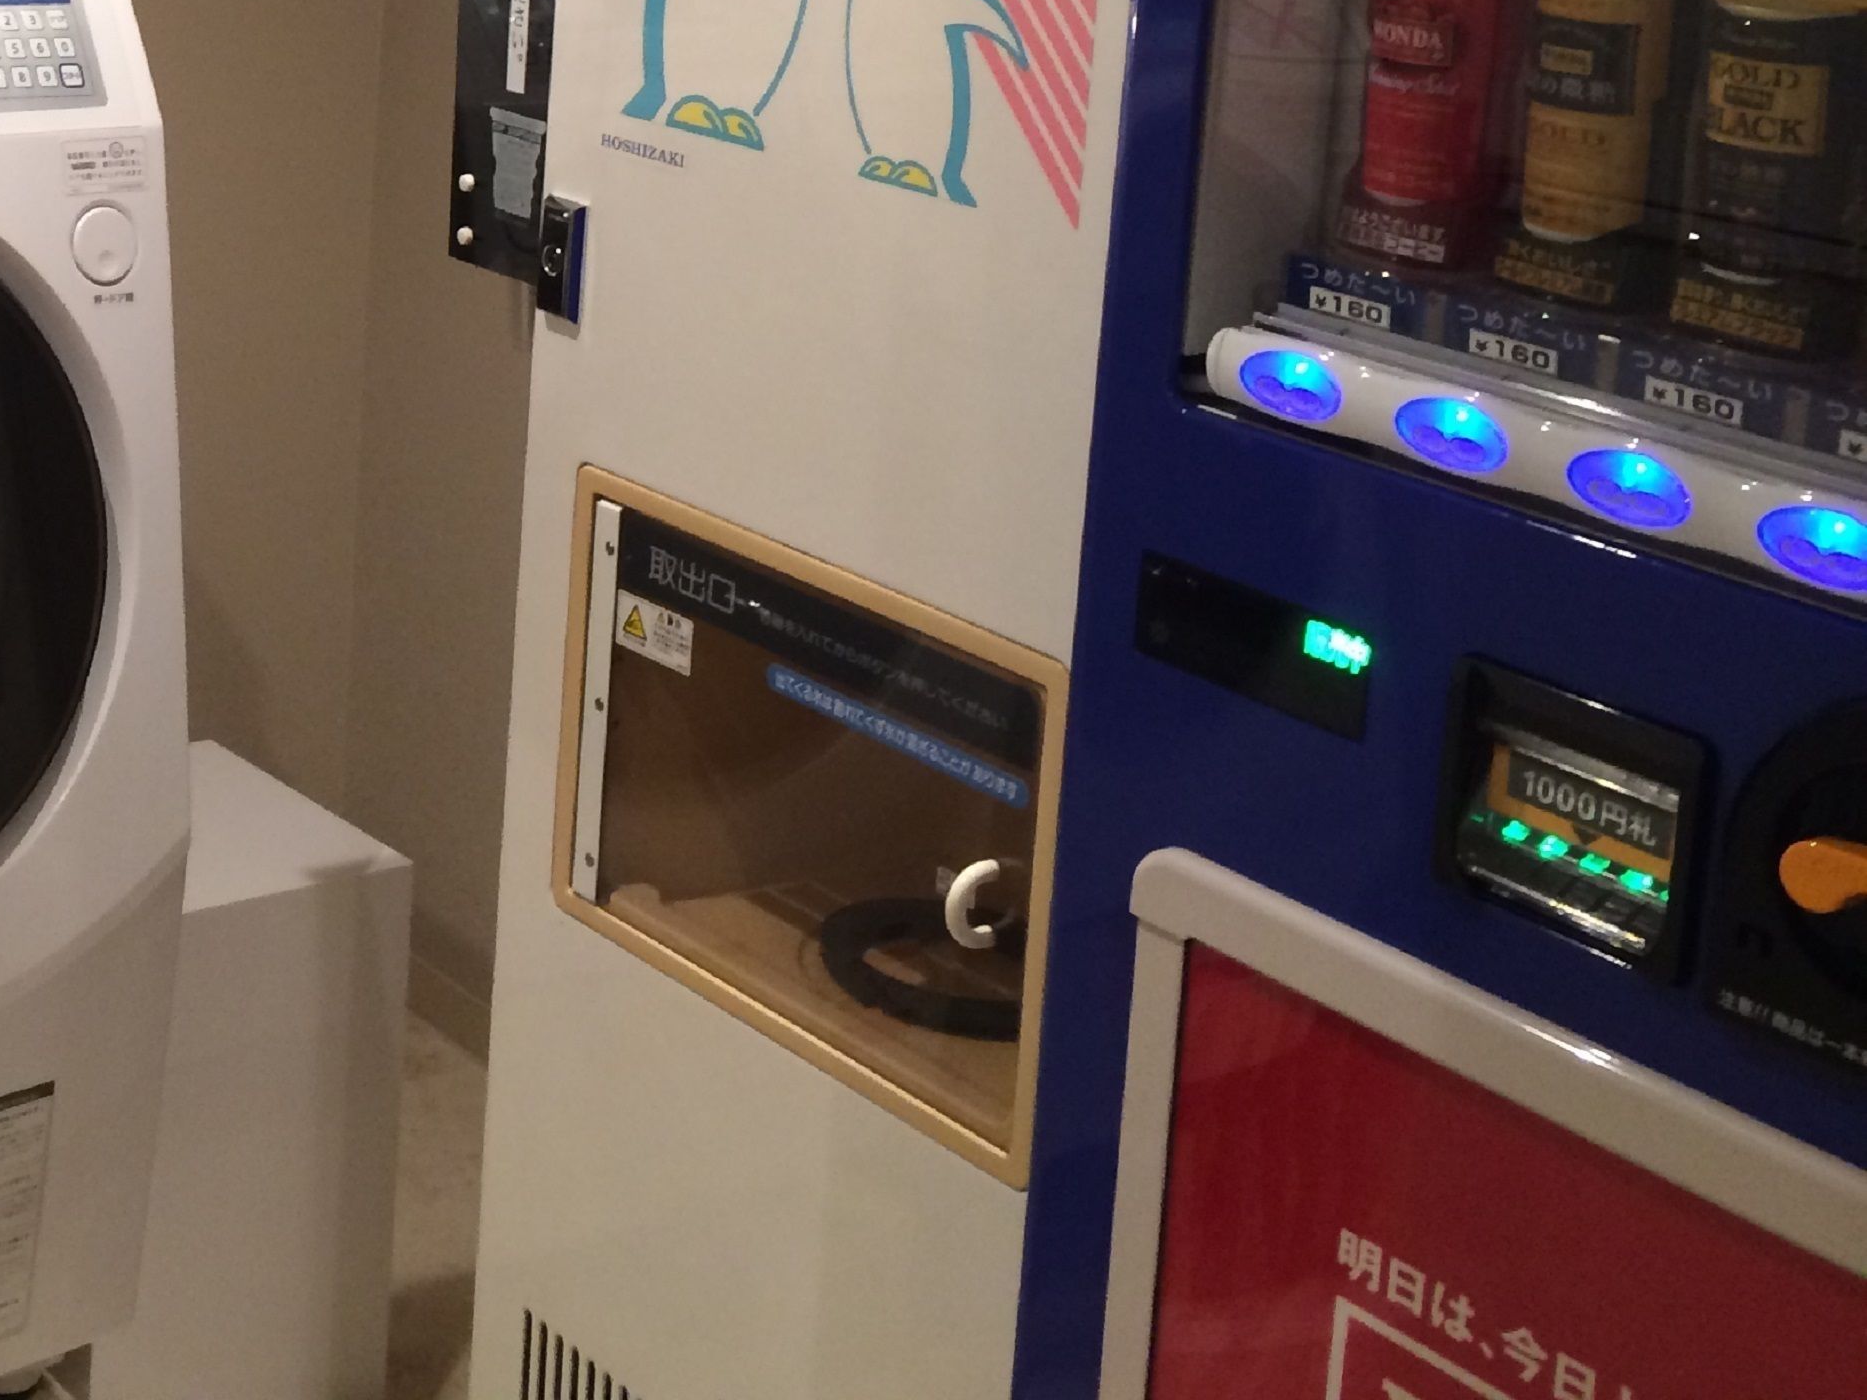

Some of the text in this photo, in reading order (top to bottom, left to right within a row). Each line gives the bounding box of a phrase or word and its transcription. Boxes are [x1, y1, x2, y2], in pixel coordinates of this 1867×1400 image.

[600, 132, 686, 169] HOSHIZAKI
[1314, 291, 1384, 326] ¥160
[1474, 337, 1552, 371] ¥160
[1651, 384, 1737, 422] ¥160
[647, 544, 734, 615] 取出口
[1521, 768, 1658, 846] 1000円札
